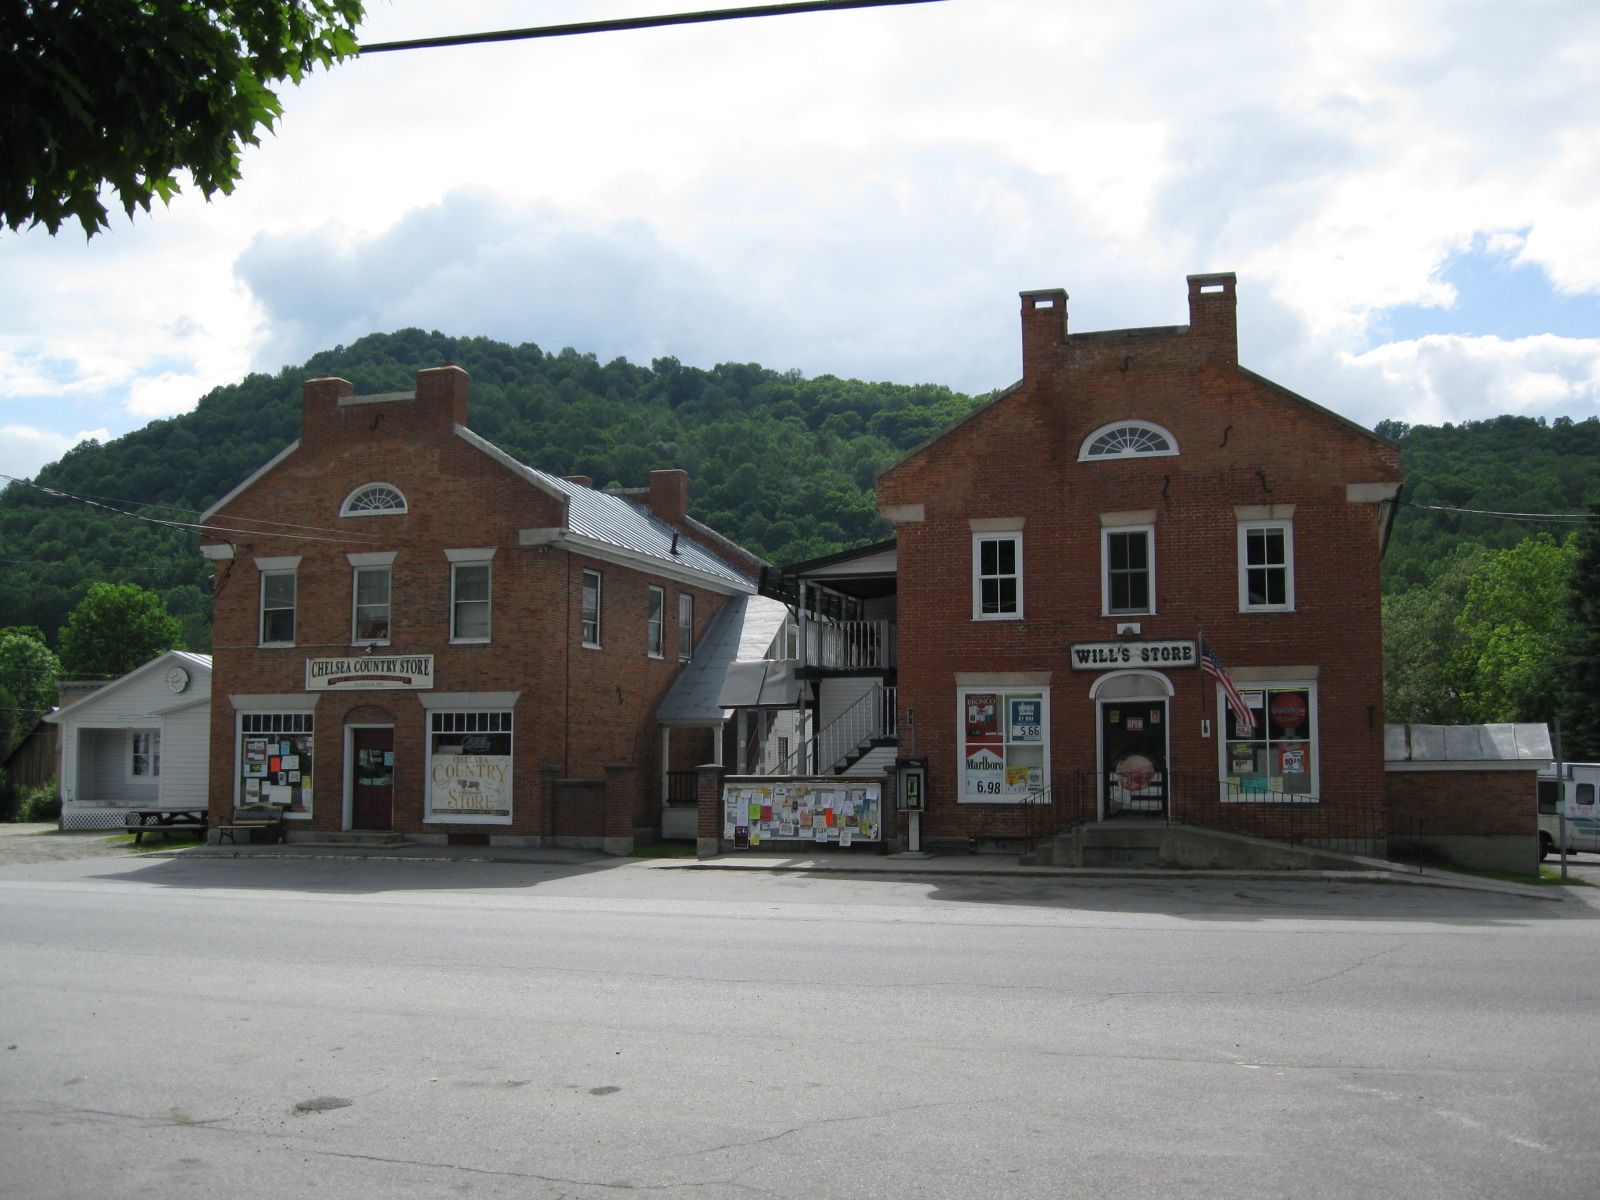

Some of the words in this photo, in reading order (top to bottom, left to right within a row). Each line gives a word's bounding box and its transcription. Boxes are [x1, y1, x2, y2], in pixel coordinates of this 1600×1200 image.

[1075, 647, 1130, 664] WILL'S
[1141, 646, 1192, 662] STORE
[311, 661, 351, 678] CHELSEA
[354, 659, 398, 674] COUNTRY
[399, 659, 430, 676] STORE
[1127, 719, 1143, 729] OPEN
[966, 756, 1003, 771] Marlboro
[432, 764, 509, 785] COUNTRY
[977, 780, 1001, 795] 6.98
[448, 788, 494, 809] STORE
